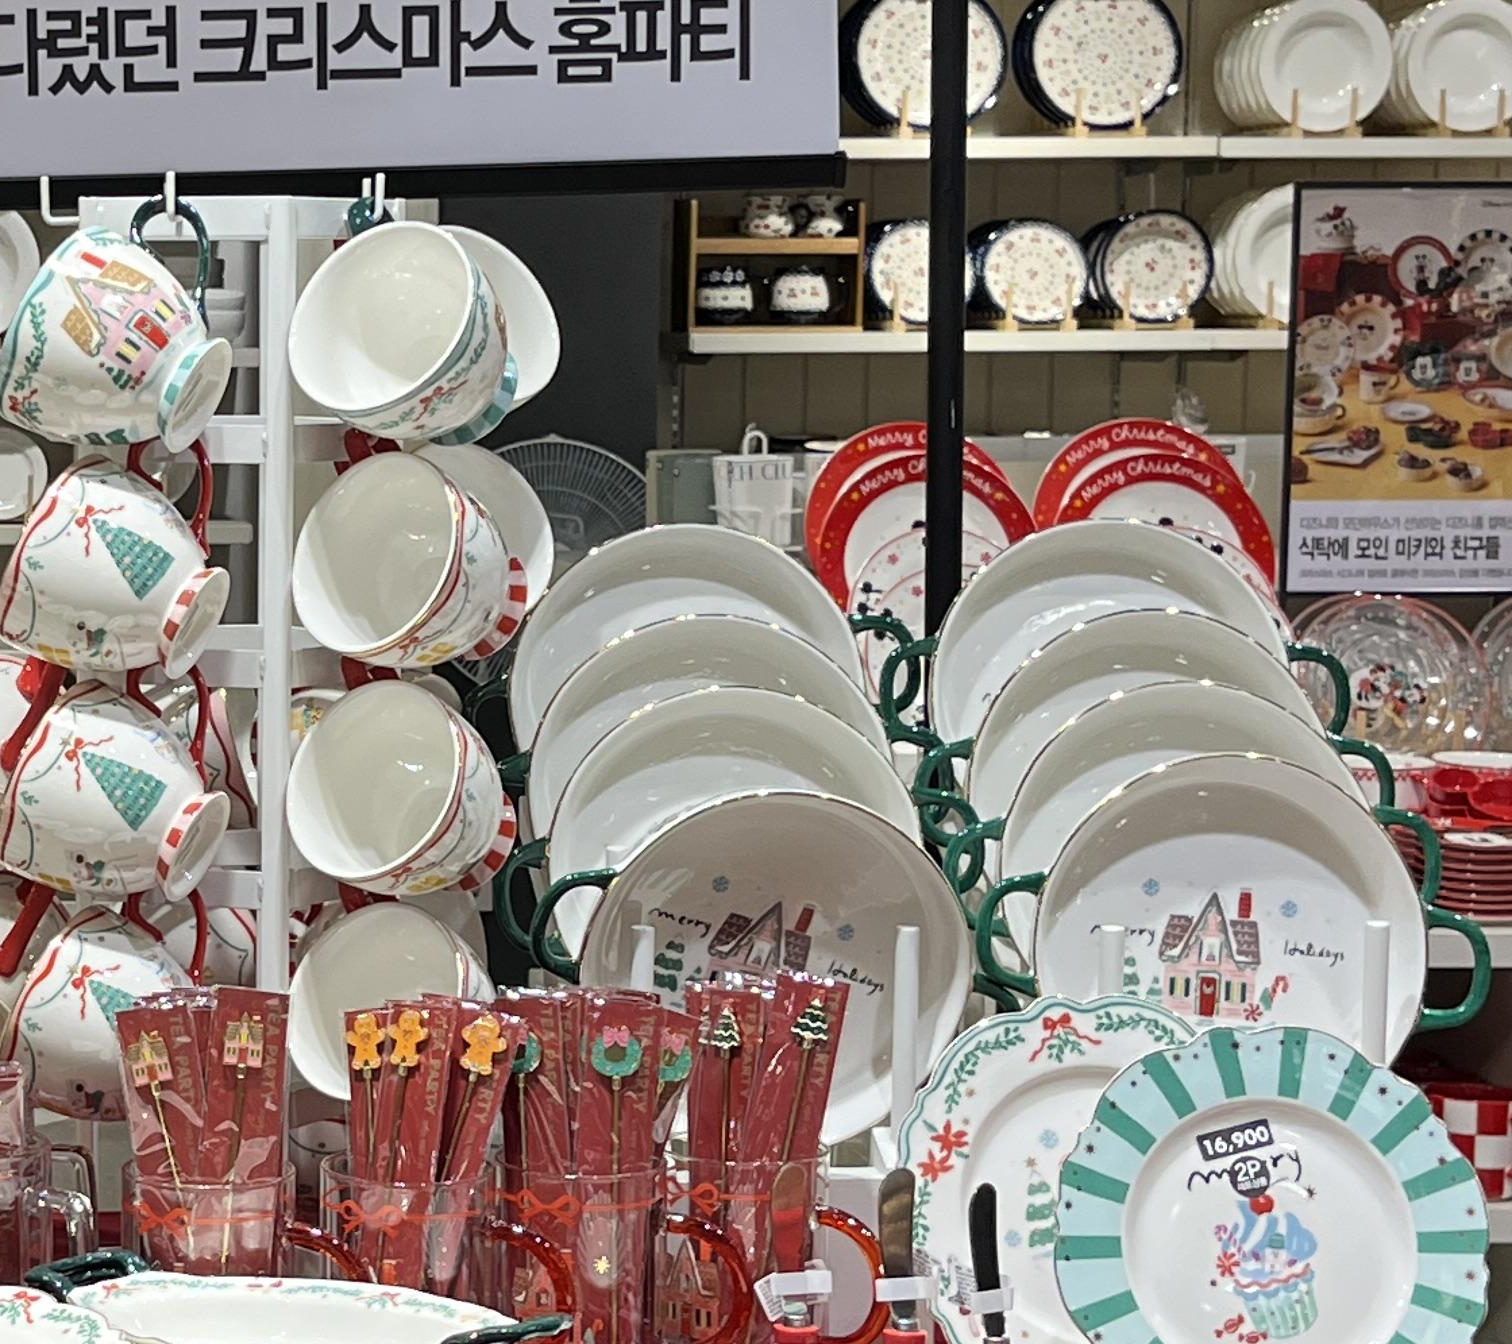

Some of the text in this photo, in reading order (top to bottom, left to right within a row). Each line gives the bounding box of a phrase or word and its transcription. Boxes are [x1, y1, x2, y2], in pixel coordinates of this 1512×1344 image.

[193, 0, 538, 92] 크리스마스
[1066, 424, 1195, 467] Merry Christmas
[1081, 457, 1212, 502] Merry Christmas
[1299, 535, 1501, 561] 식탁에 모인 미키와 친구들
[1203, 1126, 1269, 1155] 16,900
[1234, 1159, 1261, 1182] 2P
